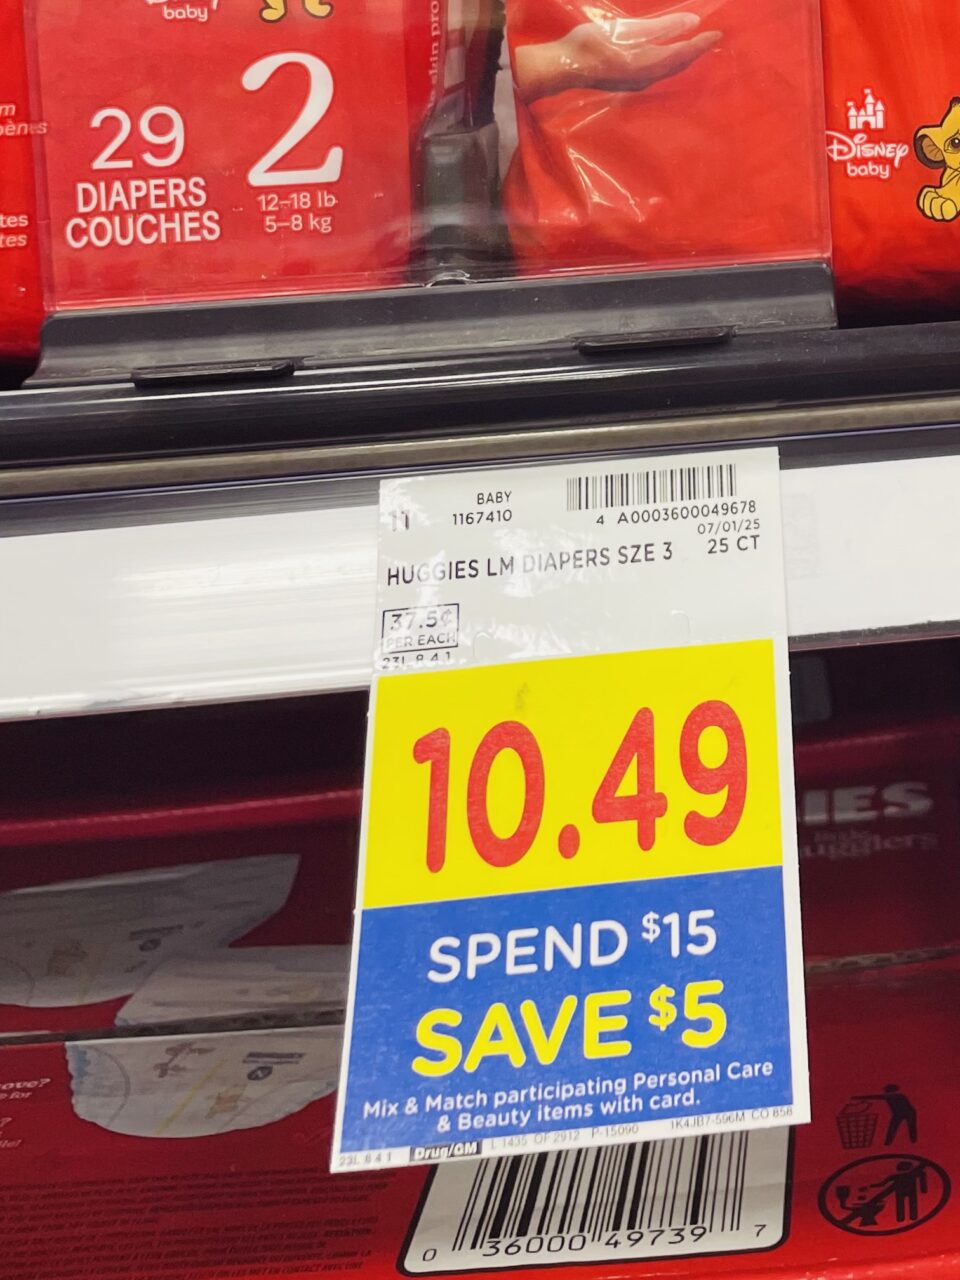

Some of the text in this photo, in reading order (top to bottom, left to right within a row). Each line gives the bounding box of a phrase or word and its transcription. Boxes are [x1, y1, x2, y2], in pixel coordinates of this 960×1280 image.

[163, 3, 209, 23] baby
[90, 106, 185, 171] 29
[240, 51, 344, 188] 2
[846, 160, 890, 180] baby
[76, 176, 207, 215] DIAPERS
[316, 190, 337, 211] lb
[66, 209, 221, 250] COUCHES
[307, 213, 333, 235] kg
[452, 501, 758, 527] 1167410 4 A0003600049678
[476, 490, 512, 506] BABY
[696, 518, 761, 535] 07/01/25
[386, 534, 761, 587] HUGGIES LM DIAPERS SZE 3 25 CT
[417, 632, 456, 646] EACH
[412, 699, 748, 874] 10.49
[427, 908, 718, 984] SPEND $15
[411, 979, 728, 1078] SAVE $5
[363, 1061, 774, 1121] Mix & Match participating Personal Care
[437, 1087, 702, 1134] & Beauty items with card.
[553, 1131, 581, 1144] 2912
[750, 1108, 770, 1120] CO
[413, 1141, 479, 1160] Drug/GM
[422, 1222, 767, 1262] 0 36000 49739 7
